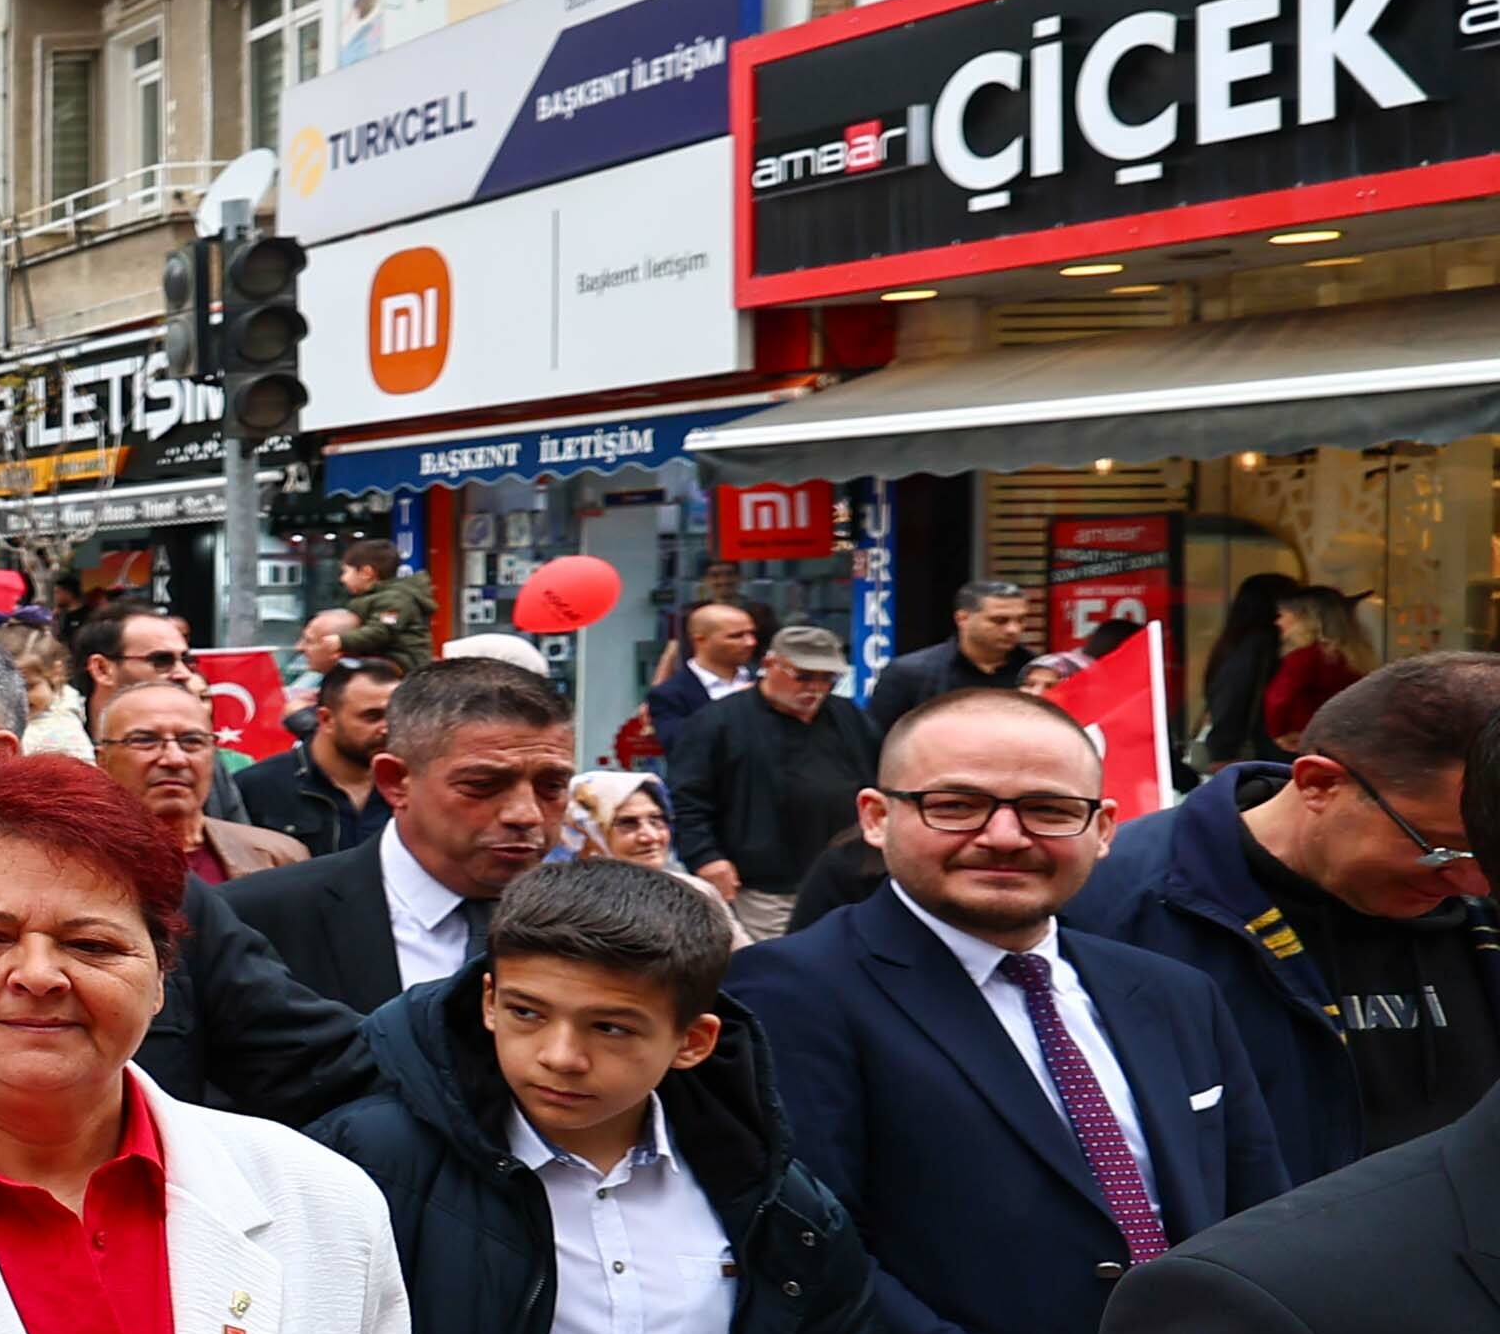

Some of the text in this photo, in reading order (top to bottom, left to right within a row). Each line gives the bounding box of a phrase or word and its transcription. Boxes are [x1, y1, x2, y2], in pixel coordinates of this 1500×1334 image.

[536, 36, 726, 122] BAŞKENT İLETİŞİM
[328, 91, 476, 170] TURKCELL
[419, 427, 655, 475] BAŞKENT İLETİŞİM
